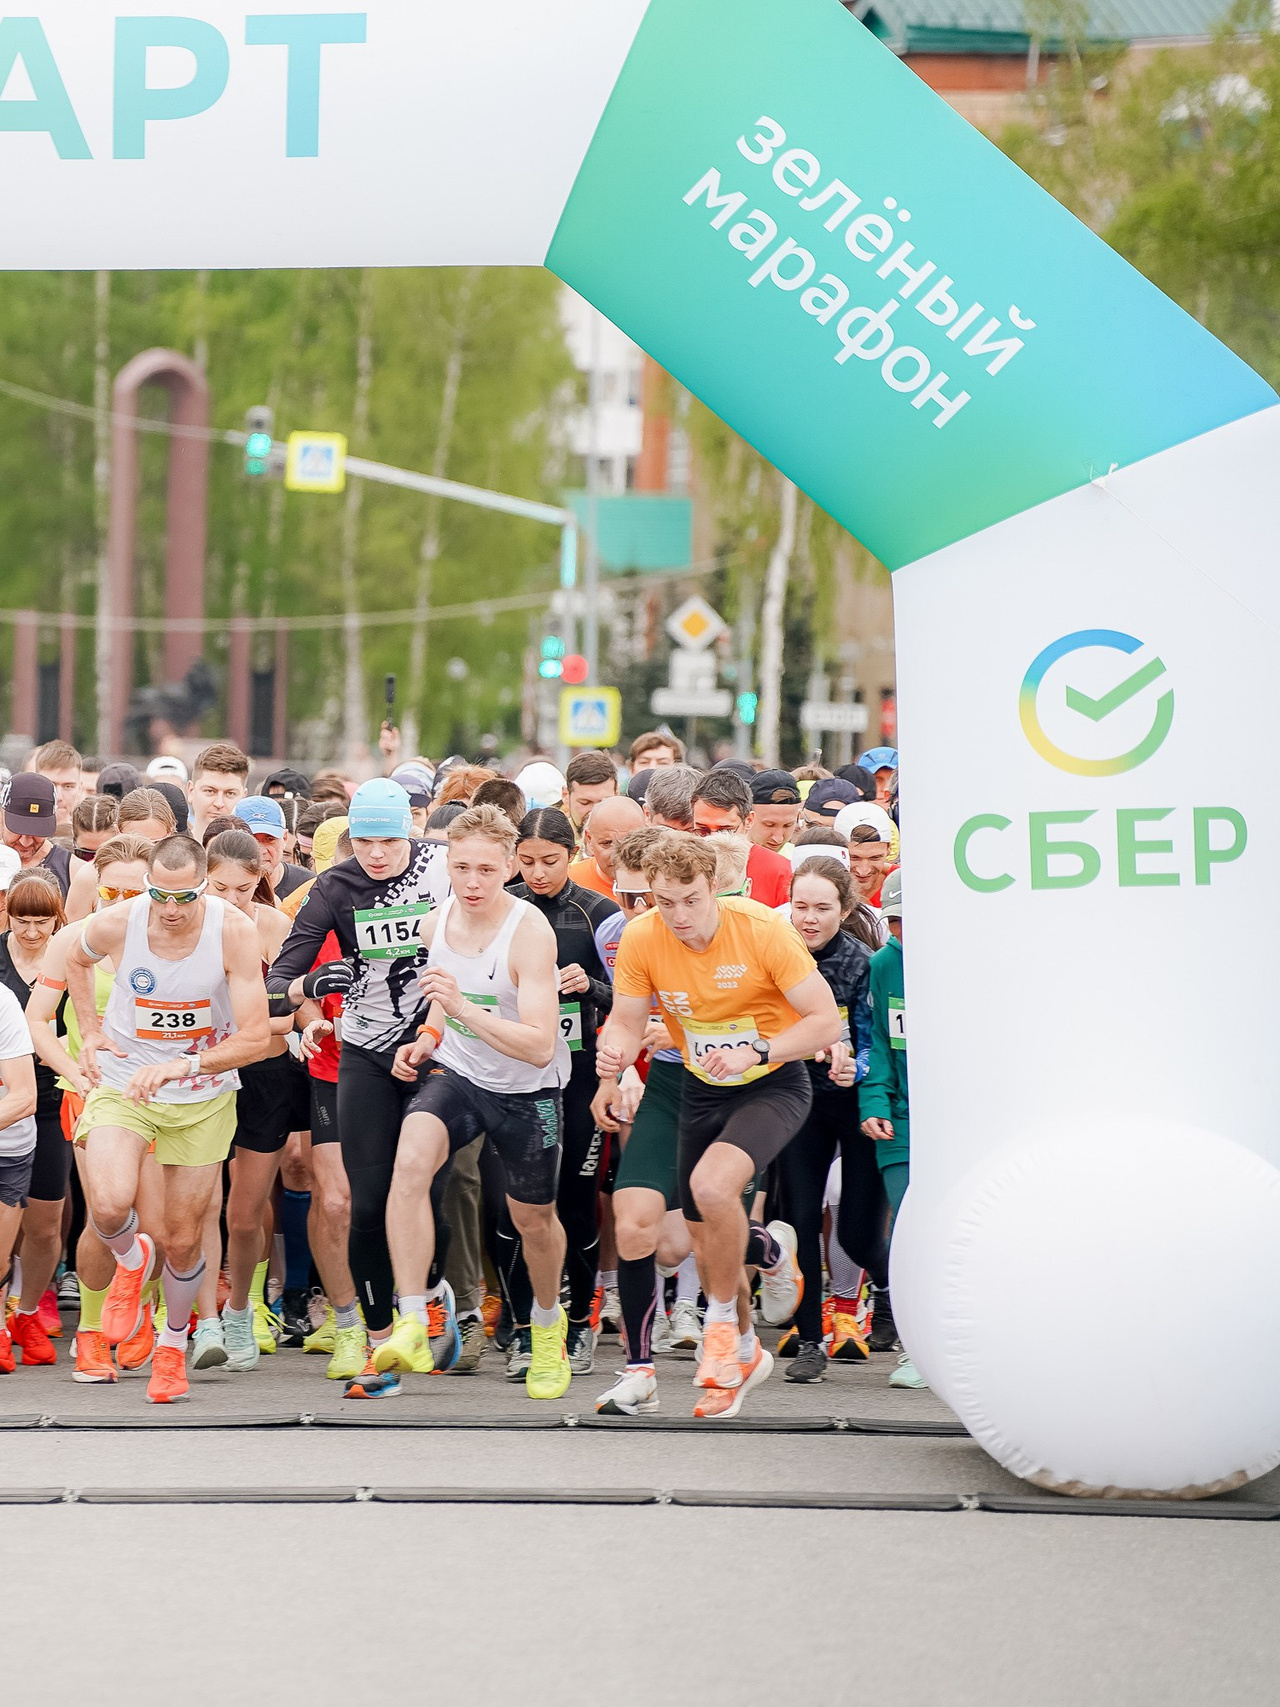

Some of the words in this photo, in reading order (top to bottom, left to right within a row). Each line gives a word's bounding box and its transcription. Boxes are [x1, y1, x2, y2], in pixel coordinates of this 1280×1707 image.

[681, 166, 972, 429] марафон
[736, 115, 1037, 377] зелёный
[953, 806, 1248, 893] СБЕР
[150, 1012, 196, 1028] 238
